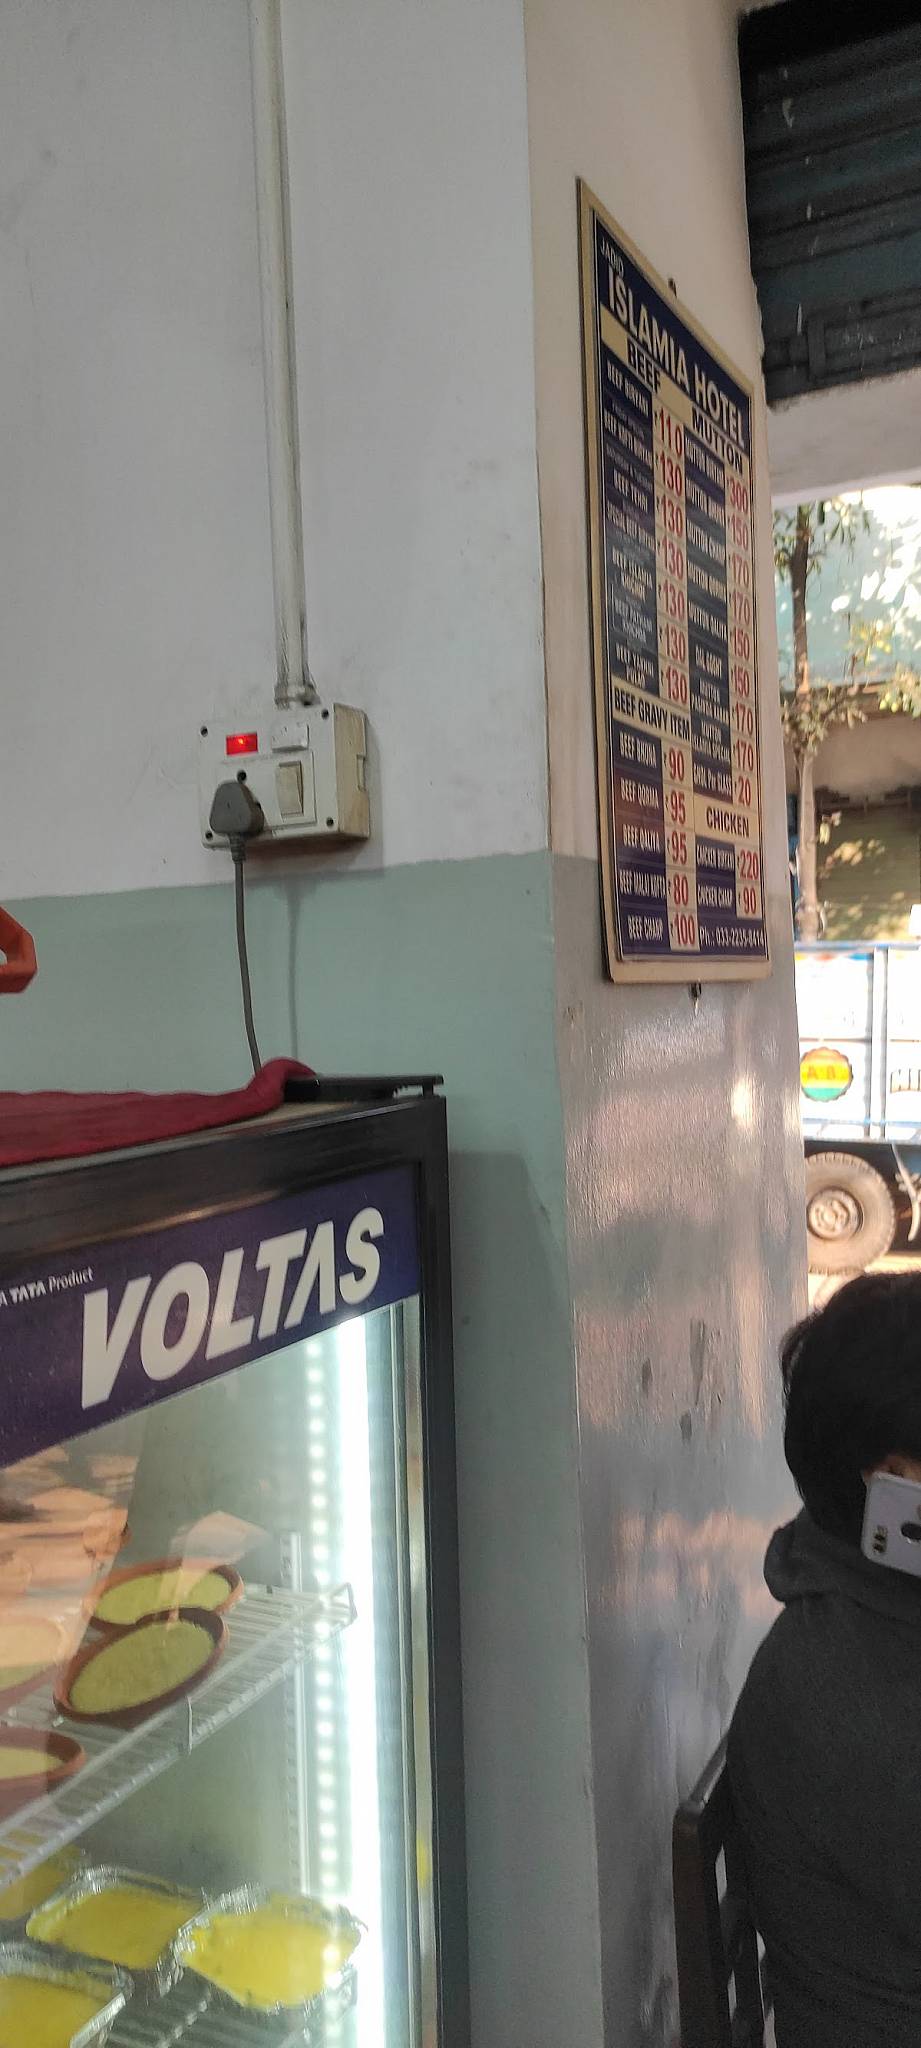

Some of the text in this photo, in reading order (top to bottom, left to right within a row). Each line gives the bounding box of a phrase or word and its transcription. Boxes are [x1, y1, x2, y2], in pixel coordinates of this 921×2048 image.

[600, 236, 624, 277] JADID
[608, 265, 745, 451] ISLAMIA HOTEL
[626, 336, 661, 396] BEEF
[691, 406, 743, 475] MUTTON
[614, 686, 690, 742] BEEF GRAVY ITEM
[619, 730, 636, 761] BEEF
[620, 776, 637, 802] BEEF
[623, 823, 639, 848] BEEF
[706, 805, 750, 839] CHICKEN
[619, 869, 633, 895] BEEF
[627, 914, 643, 941] BEEF
[9, 1280, 47, 1304] TATA
[48, 1266, 95, 1293] Product
[81, 1206, 385, 1411] VOLTAS
